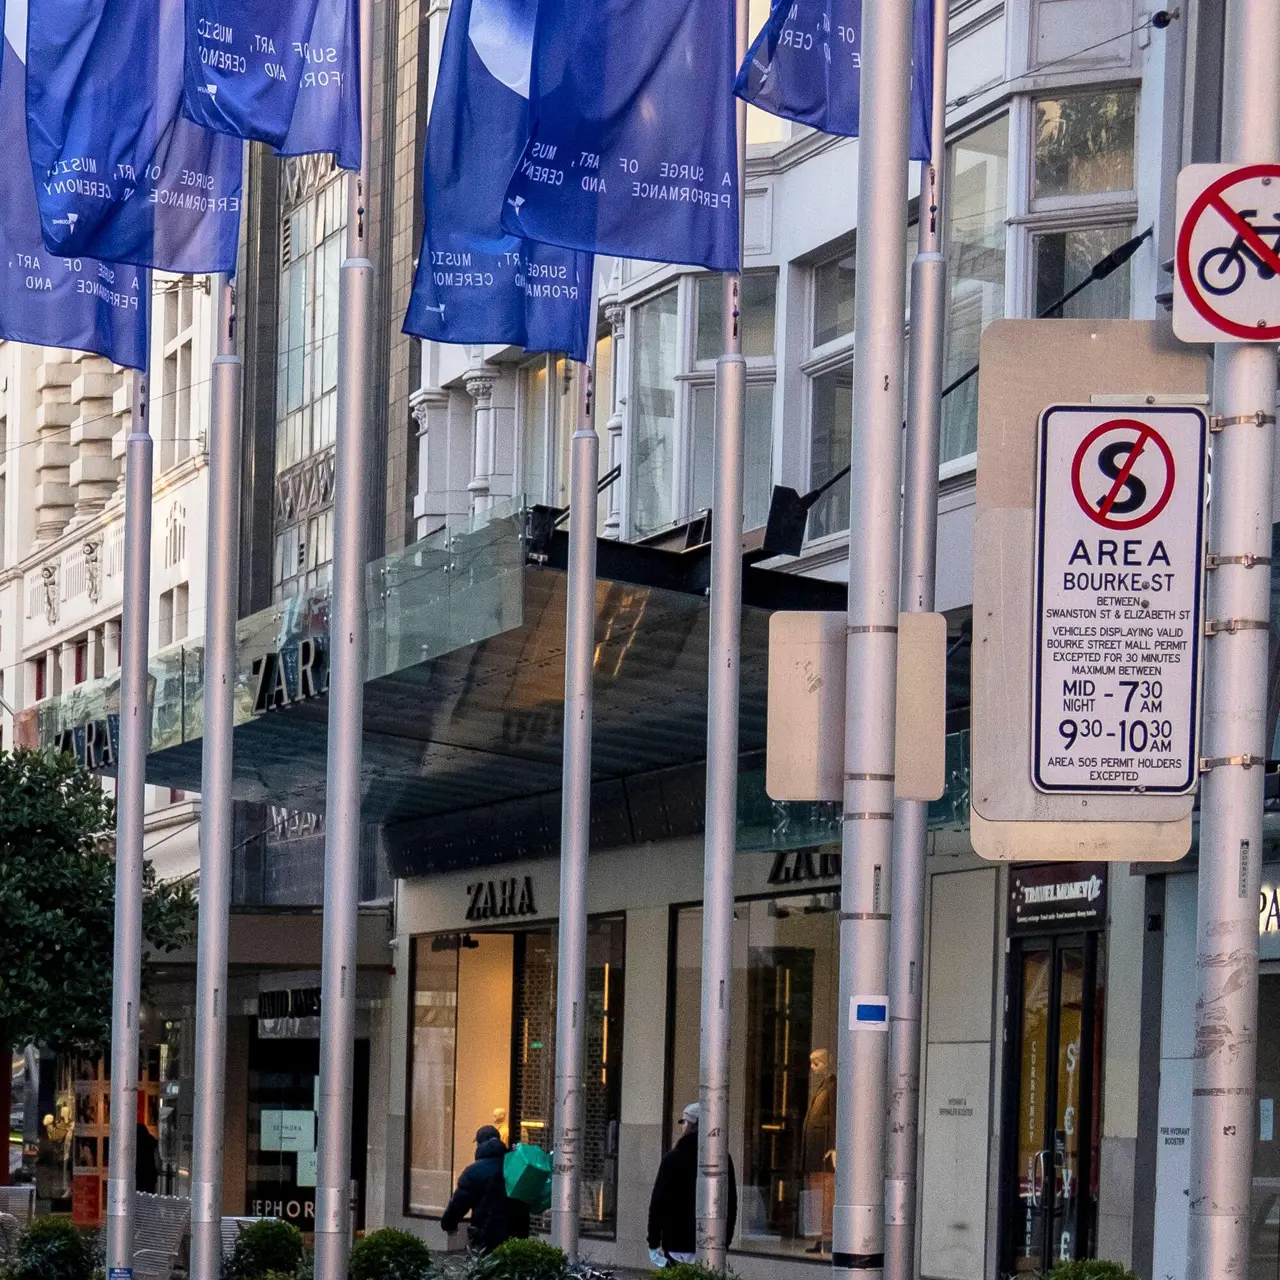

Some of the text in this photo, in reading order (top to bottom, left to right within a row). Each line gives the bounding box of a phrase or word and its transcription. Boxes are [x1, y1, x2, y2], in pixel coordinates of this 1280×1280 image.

[1068, 539, 1171, 566] AREA
[1063, 572, 1175, 592] BOURKE ST
[1096, 596, 1140, 606] BETWEEN
[1046, 609, 1190, 620] SWANSTON ST & ELIZABETH ST
[1052, 627, 1183, 637] VEHICLES DISPLAYING VALID
[1047, 640, 1188, 650] BOURKE STREET MALL PERMIT
[1053, 652, 1181, 663] EXCEPTED FOR 30 MINUTES
[1072, 665, 1162, 676] MAXIMUM BETWEEN
[252, 637, 330, 716] ZAR
[1063, 680, 1095, 697] MID
[1063, 698, 1162, 713] NIGHT AM
[1150, 740, 1171, 752] AM
[1048, 757, 1182, 768] AREA 505 PERMIT HOLDERS
[1090, 771, 1138, 781] EXCEPTED
[465, 876, 538, 920] ZARA
[1160, 1127, 1190, 1136] FIRE HYDRANT
[1164, 1137, 1185, 1146] BOOSTER
[252, 1200, 315, 1217] SEPHOR
